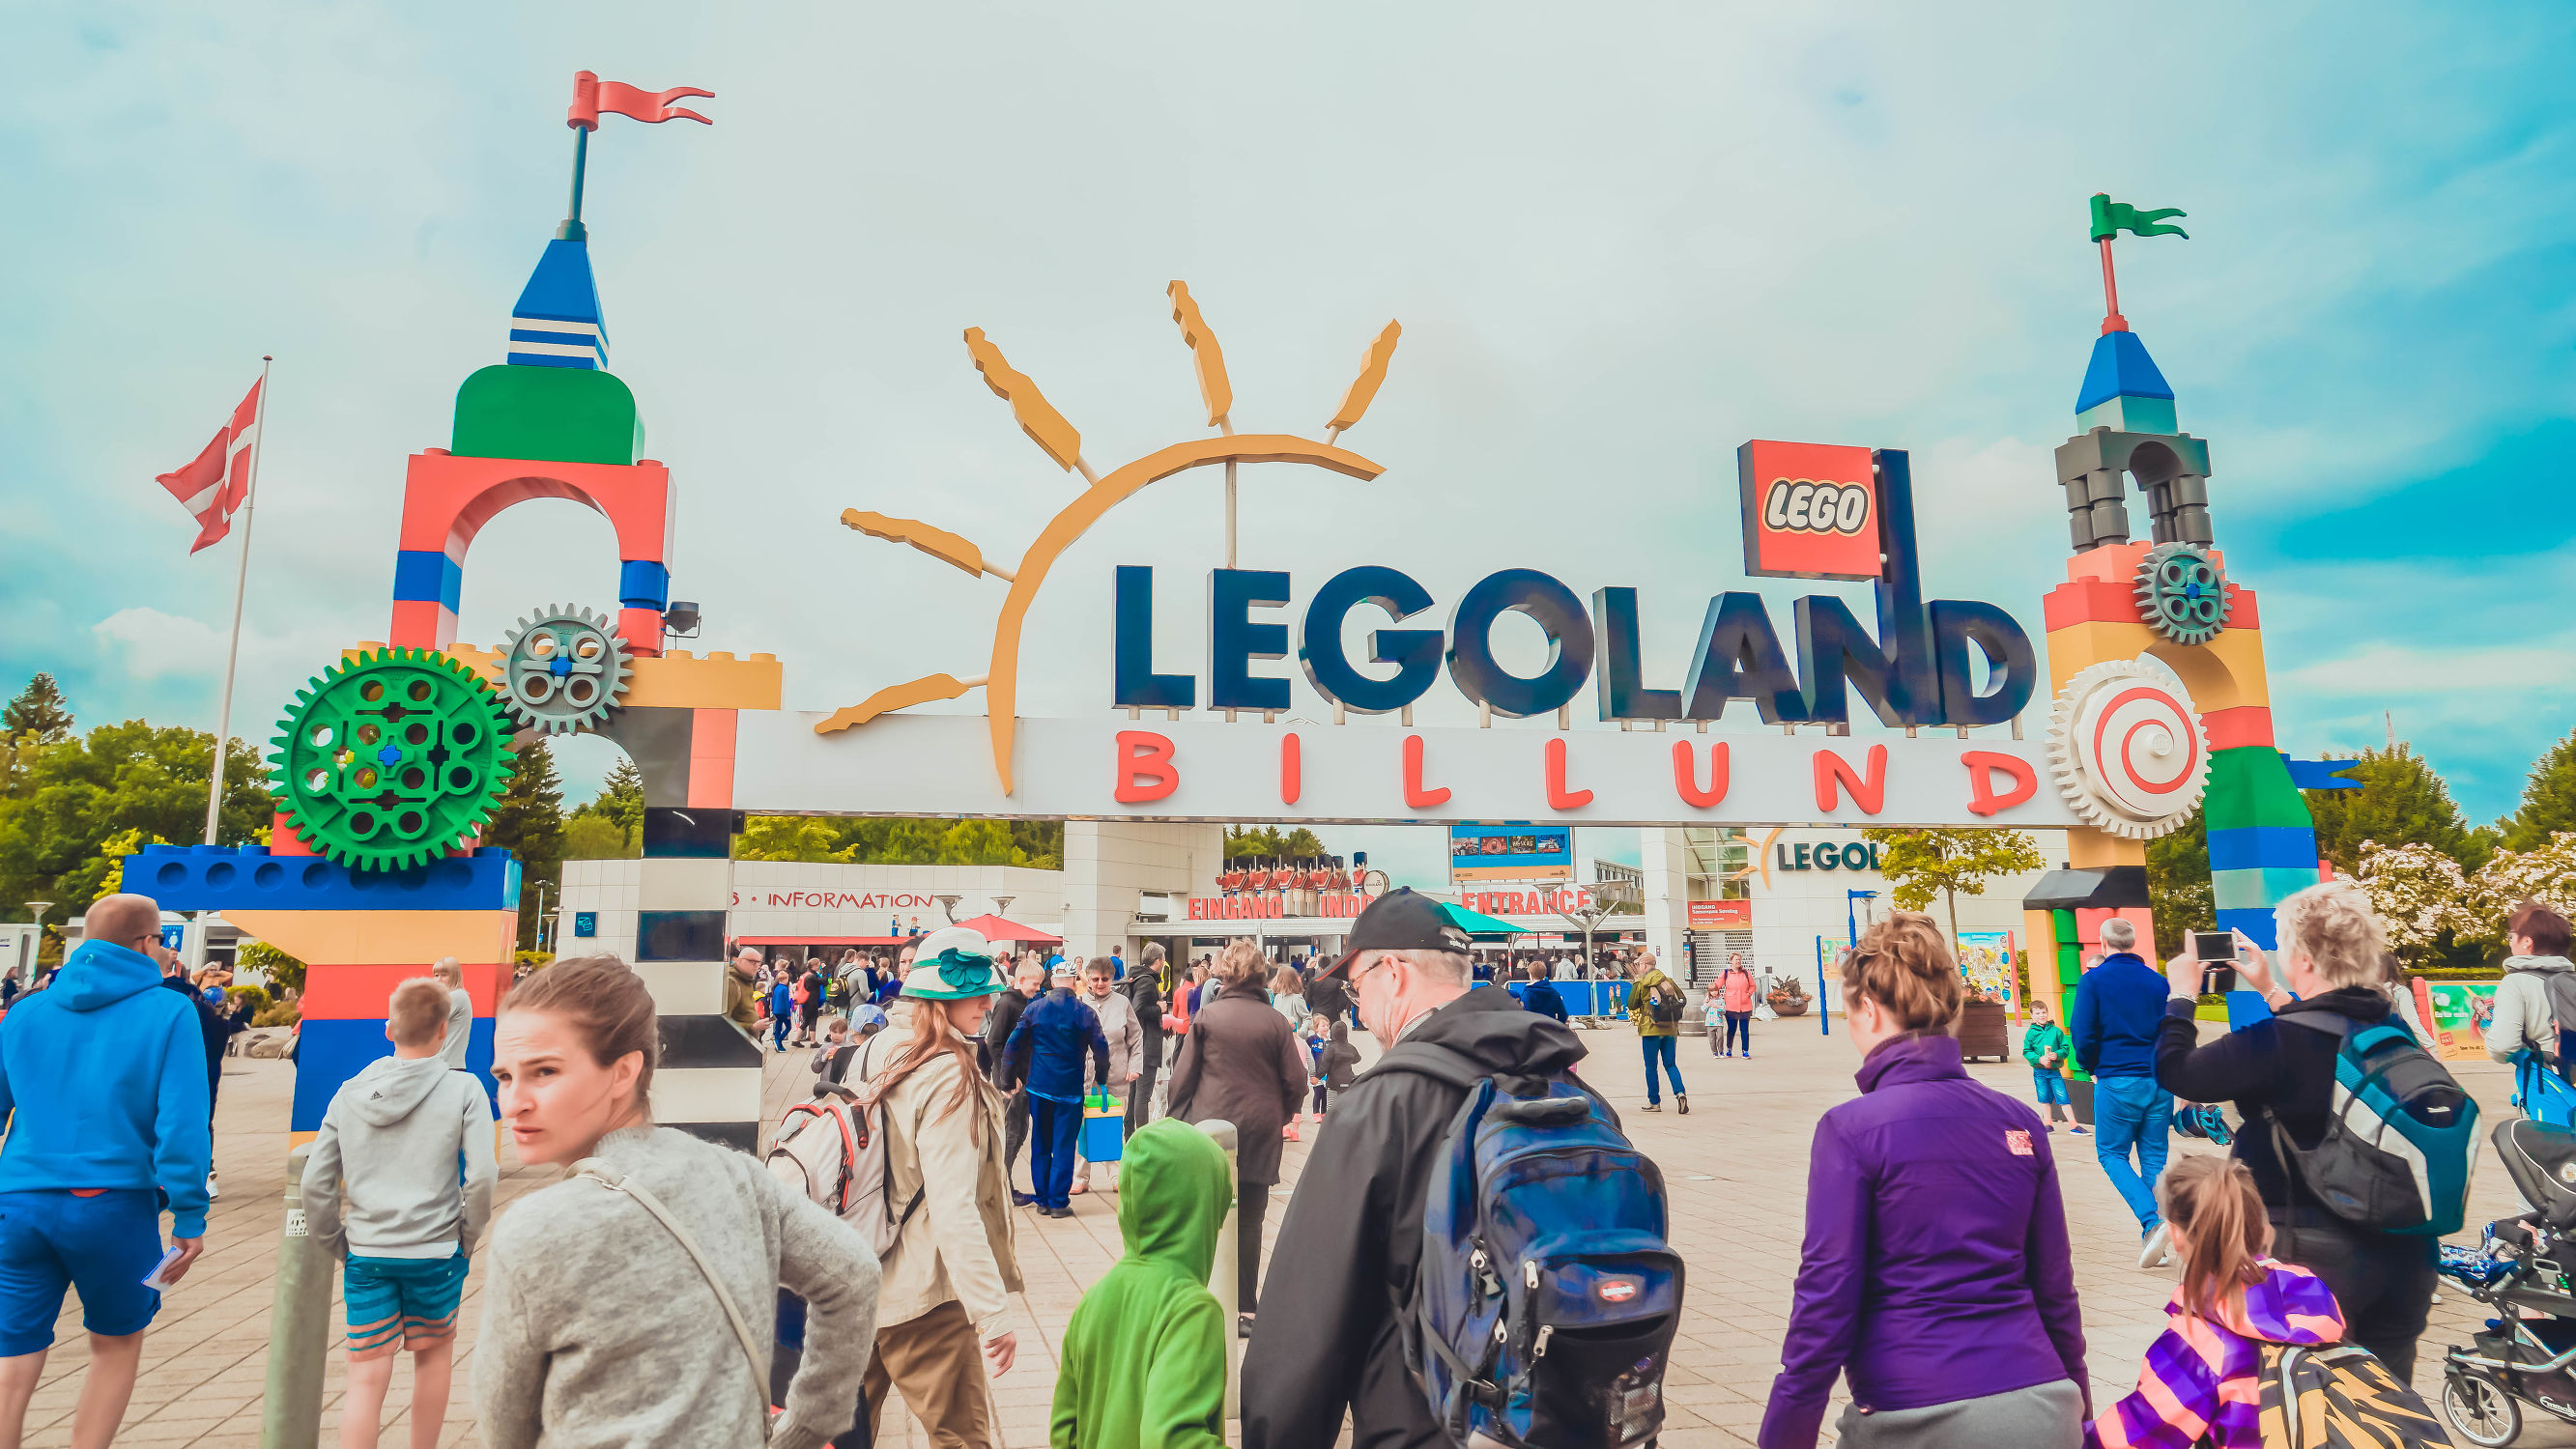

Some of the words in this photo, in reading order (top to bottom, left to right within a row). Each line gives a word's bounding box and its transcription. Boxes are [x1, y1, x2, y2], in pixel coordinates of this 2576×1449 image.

[1765, 479, 1868, 533] LEGO
[1111, 563, 2037, 727] LEGOLAND
[1113, 729, 2038, 816] BILLUND
[767, 891, 934, 909] INFORMATION
[1188, 896, 1284, 921] EINGANG
[1462, 890, 1591, 916] ENTRANCE
